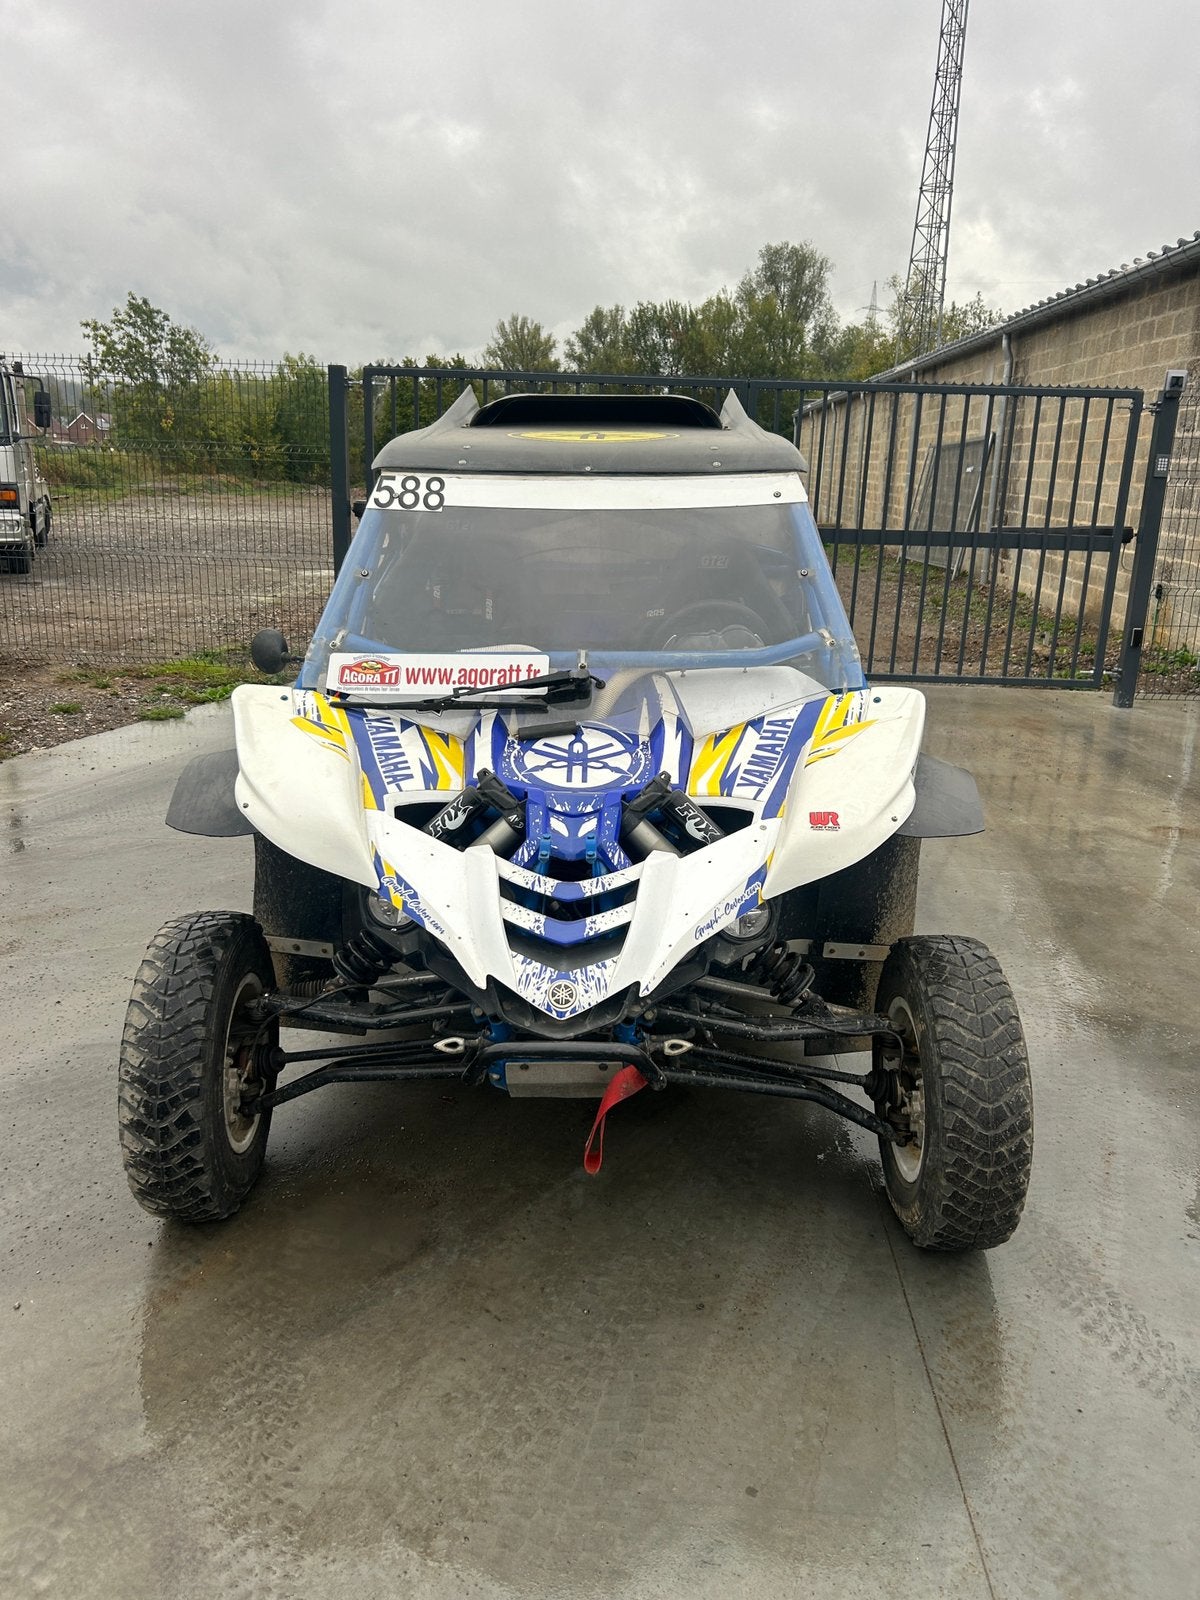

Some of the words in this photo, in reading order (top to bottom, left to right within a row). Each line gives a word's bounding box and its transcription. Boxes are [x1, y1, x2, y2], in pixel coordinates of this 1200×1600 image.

[374, 475, 445, 510] 588
[342, 669, 381, 683] AGORA
[384, 669, 398, 684] TT
[366, 716, 415, 786] YAMAHA
[737, 716, 794, 789] YAMAHA
[428, 796, 472, 840] FOX
[675, 802, 721, 844] FOX
[809, 811, 840, 826] WR
